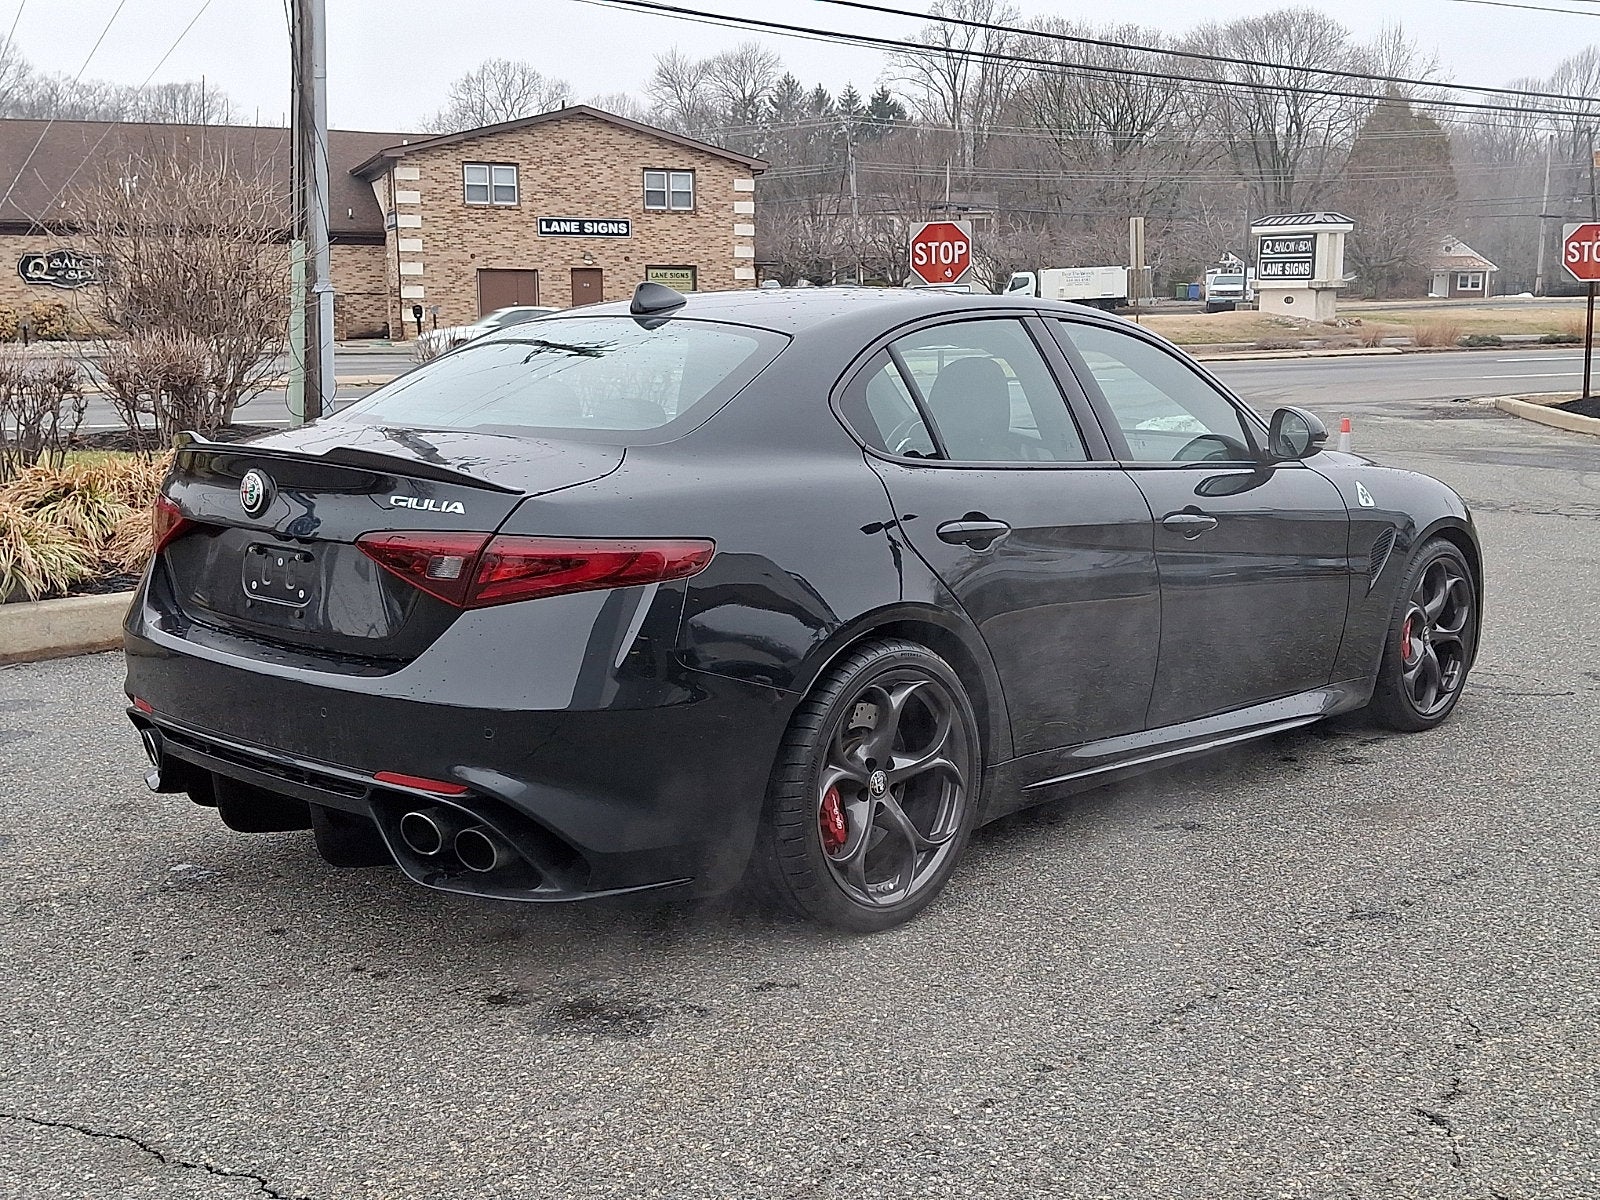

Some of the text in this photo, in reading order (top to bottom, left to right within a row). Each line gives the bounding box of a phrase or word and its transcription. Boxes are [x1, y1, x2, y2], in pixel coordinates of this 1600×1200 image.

[541, 220, 628, 234] LANE SIGNS
[914, 240, 967, 265] STOP
[1262, 240, 1275, 254] Q
[1567, 241, 1600, 263] STO
[26, 257, 57, 280] Q
[1261, 262, 1310, 275] LANE SIGNS
[389, 495, 466, 515] GIULIA
